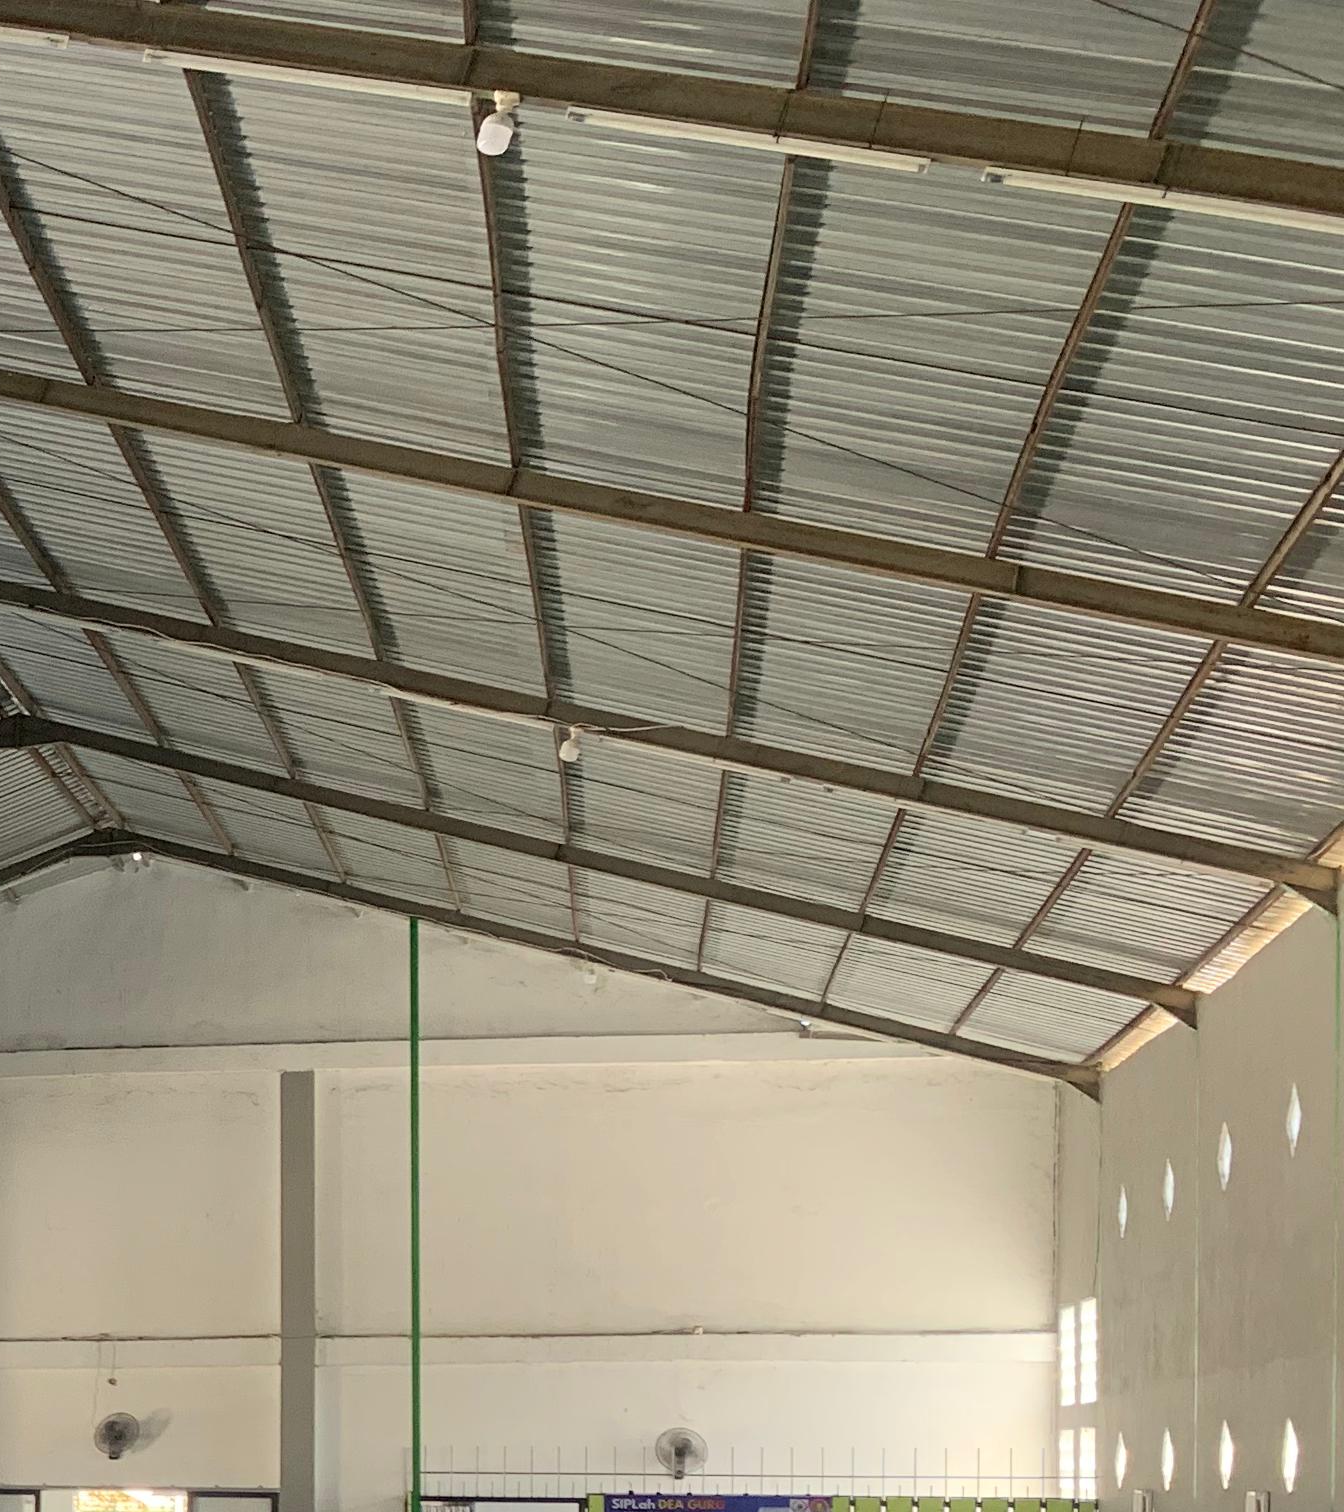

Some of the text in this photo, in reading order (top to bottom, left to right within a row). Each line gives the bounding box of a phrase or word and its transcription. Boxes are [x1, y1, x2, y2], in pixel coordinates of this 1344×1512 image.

[611, 1498, 725, 1511] SIPLah DEA GURU
